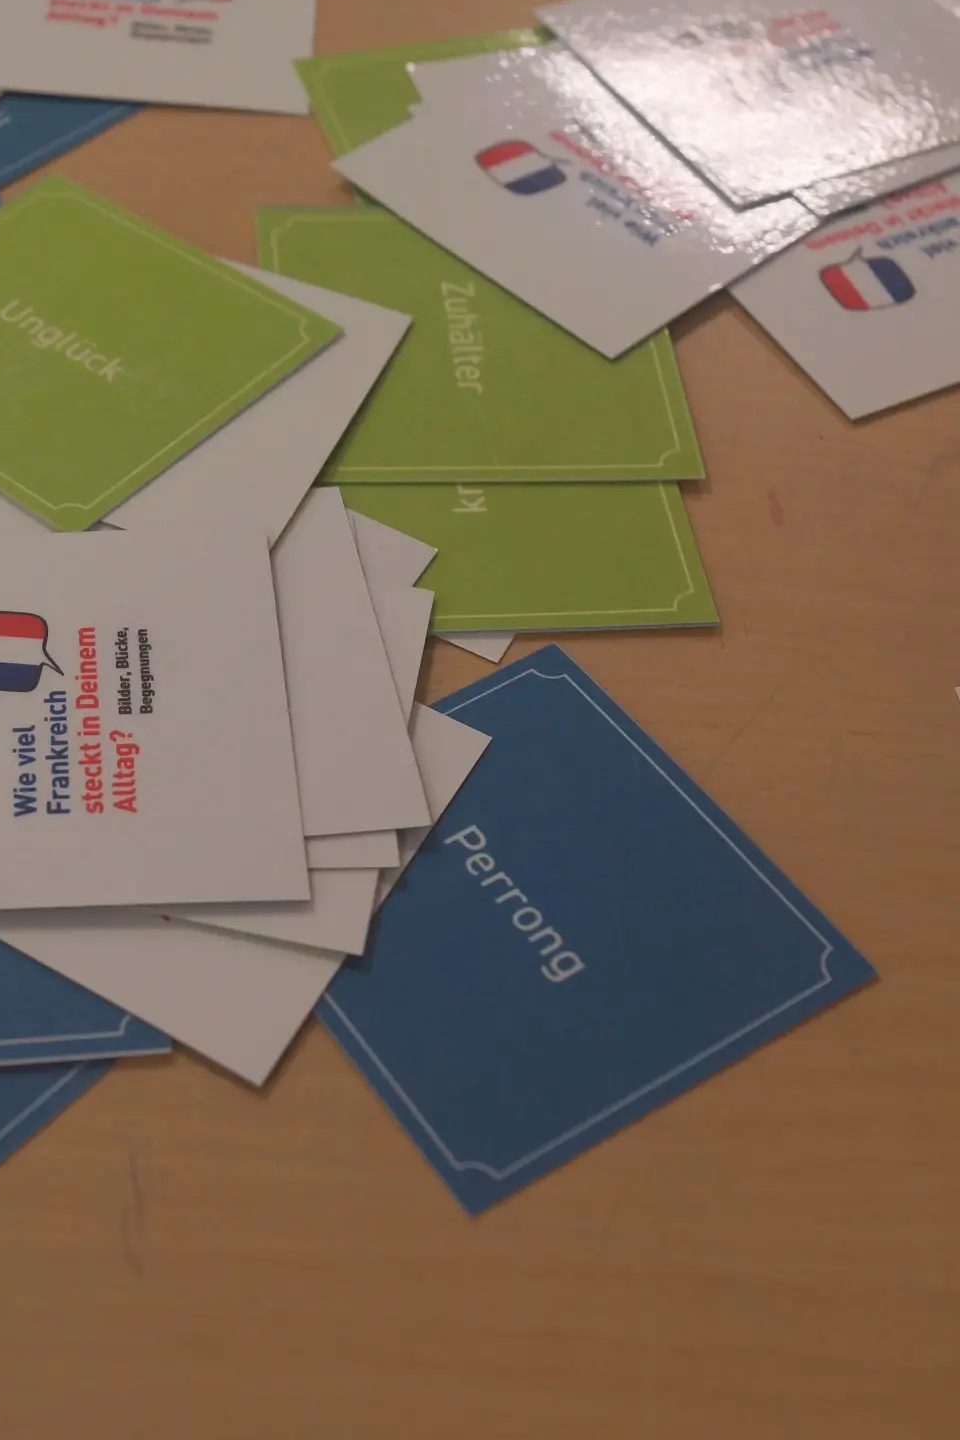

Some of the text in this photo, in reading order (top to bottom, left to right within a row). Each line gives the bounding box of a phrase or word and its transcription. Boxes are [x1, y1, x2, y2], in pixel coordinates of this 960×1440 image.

[0, 298, 125, 383] Unglück
[441, 280, 484, 396] Zuhälter
[114, 627, 133, 715] Bilder, Blicke,
[136, 627, 156, 715] Begegnungen
[44, 689, 71, 815] Frankreich
[74, 626, 105, 814] steckt in Deinem
[12, 724, 38, 817] Wie viel
[109, 728, 141, 814] Alltag?
[443, 824, 587, 983] Perrong
